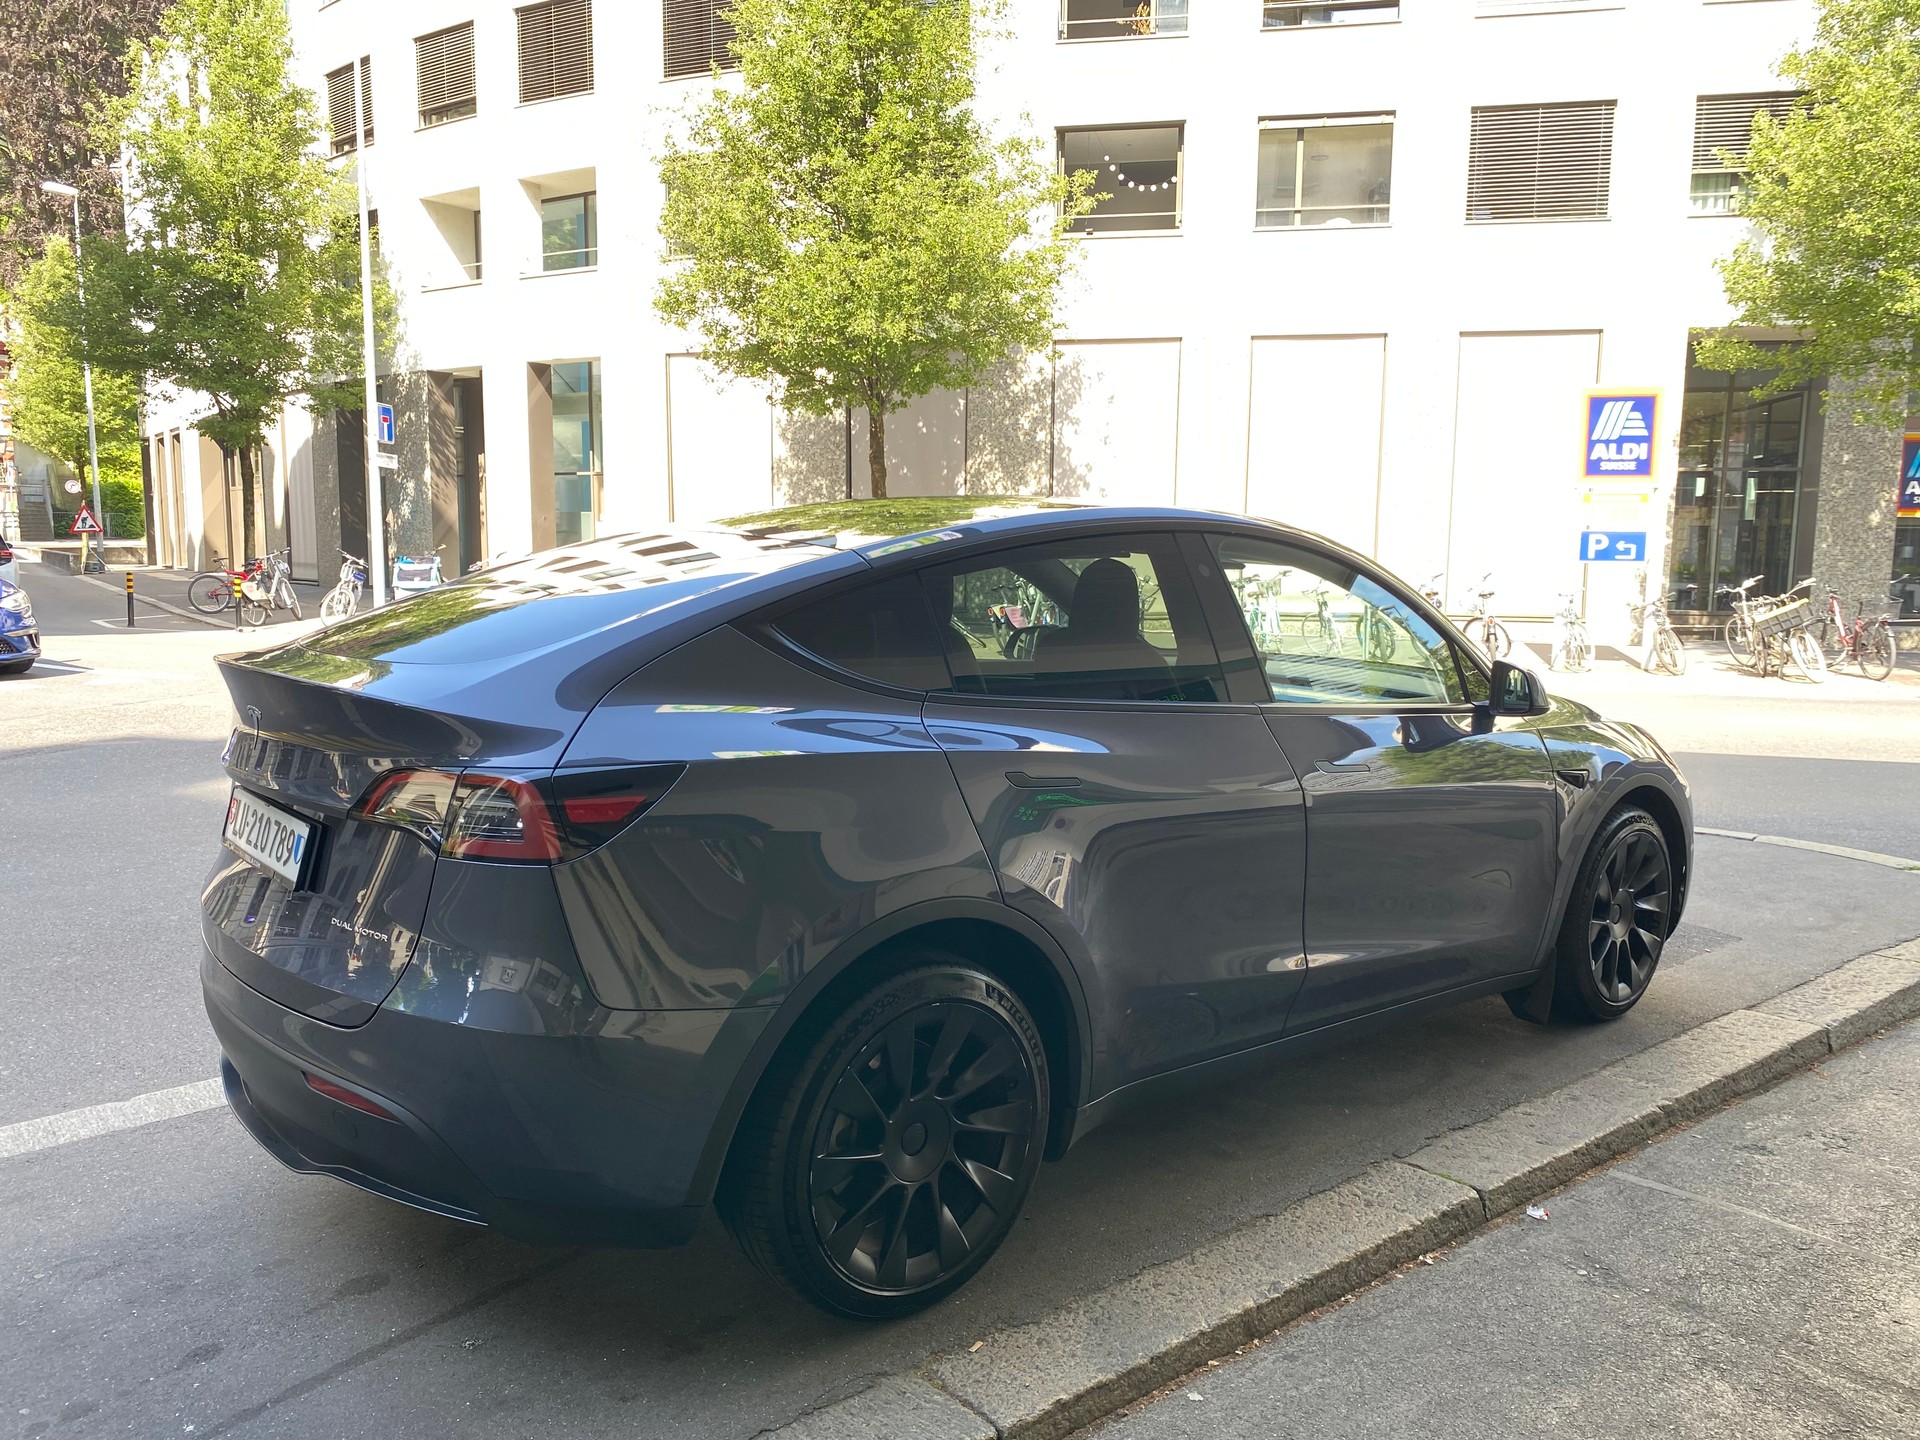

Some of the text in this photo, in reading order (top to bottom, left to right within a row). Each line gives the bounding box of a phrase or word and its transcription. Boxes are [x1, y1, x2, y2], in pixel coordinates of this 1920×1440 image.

[1589, 442, 1649, 461] ALDI
[1587, 533, 1609, 559] P
[330, 917, 389, 942] DUAL MOTOR
[1000, 996, 1043, 1067] MICHELIN
